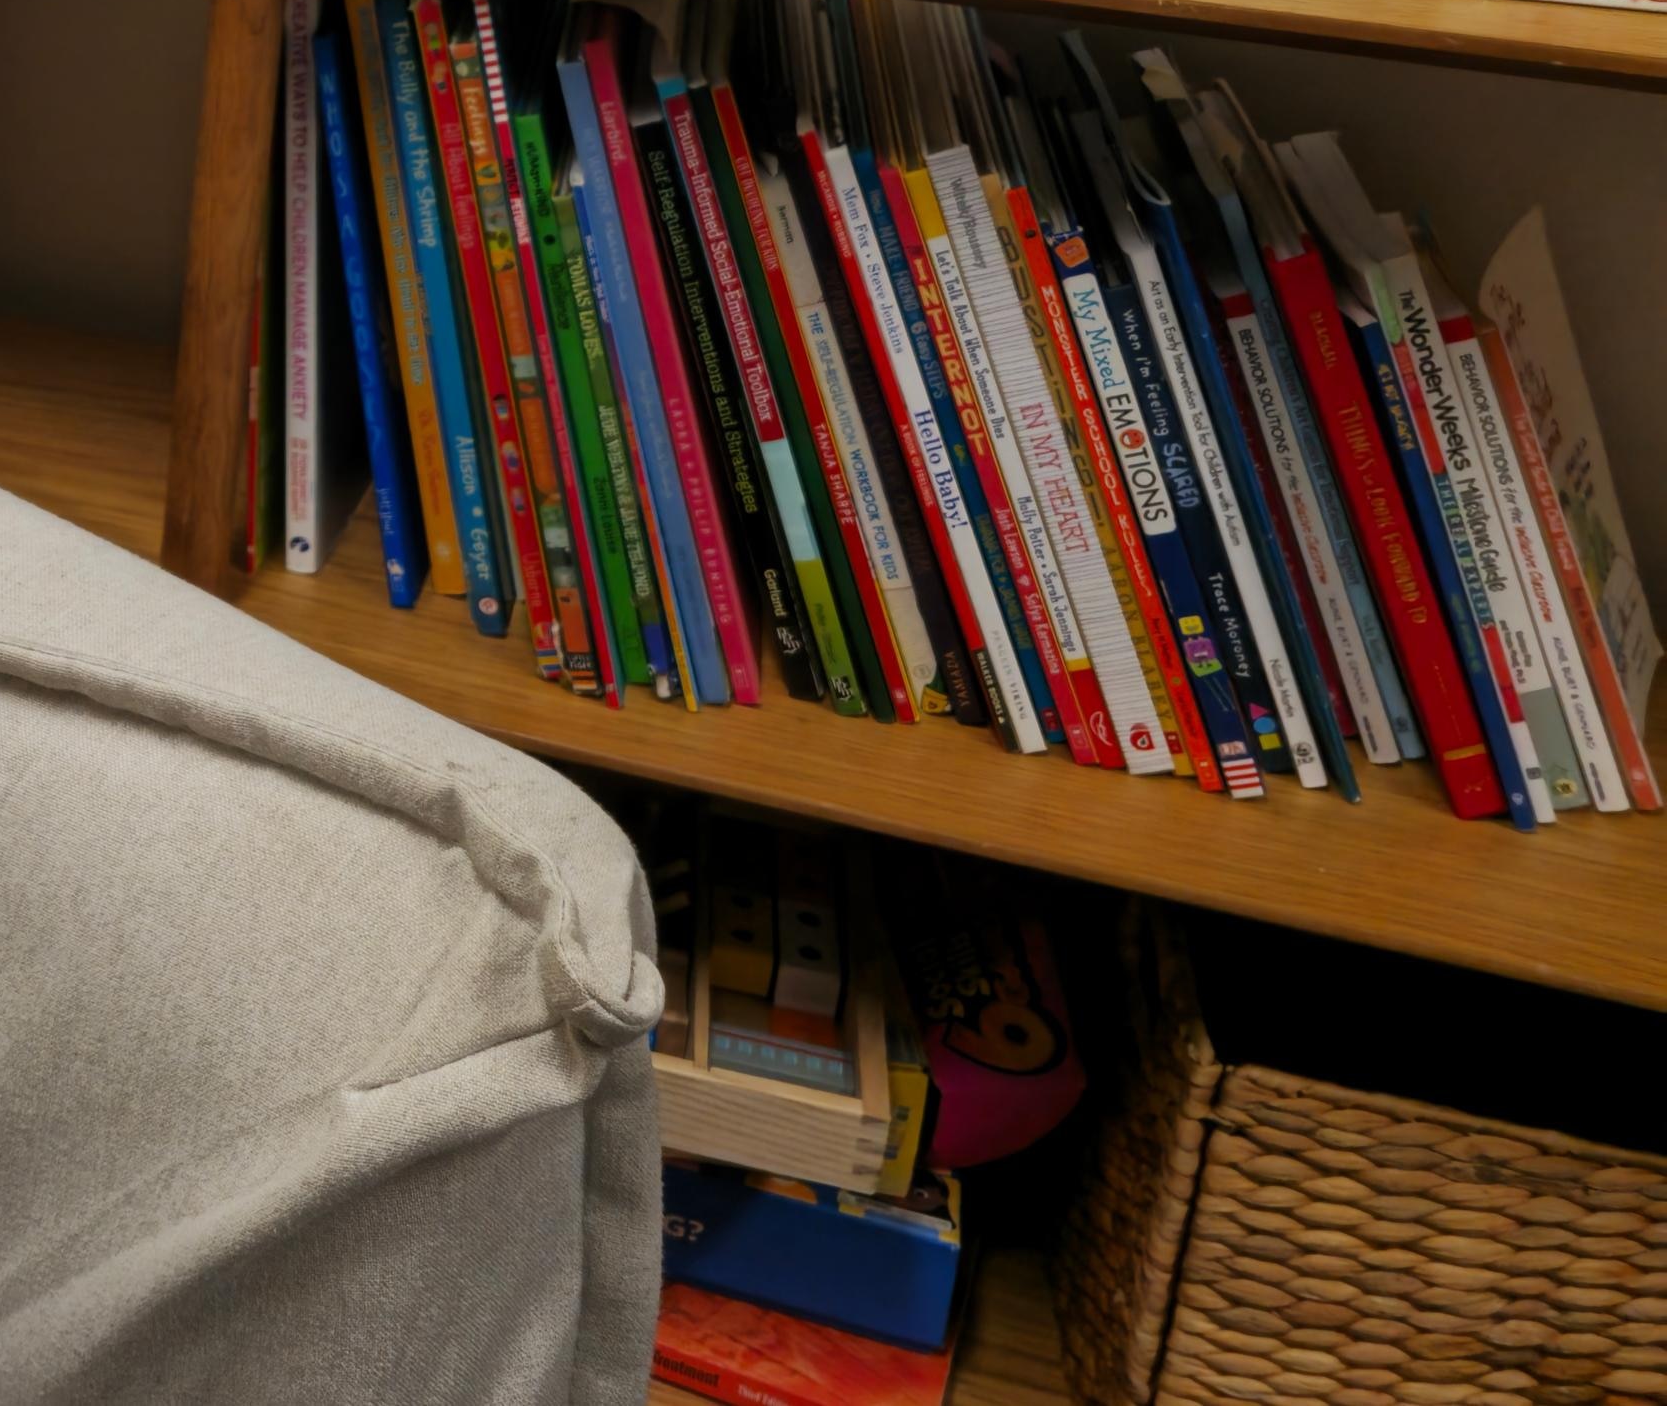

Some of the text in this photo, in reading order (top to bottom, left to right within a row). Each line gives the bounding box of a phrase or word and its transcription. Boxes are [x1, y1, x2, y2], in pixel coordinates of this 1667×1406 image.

[290, 72, 308, 121] WAYS
[459, 84, 496, 157] Feelings
[292, 126, 307, 147] TO
[389, 20, 442, 249] The Bully and the Shrimp
[445, 145, 471, 193] About
[292, 152, 308, 192] HELP
[292, 197, 308, 276] CHILDREN
[451, 192, 482, 250] Feelings
[566, 255, 591, 308] TOMAS
[671, 109, 779, 426] Trauma-Informed Social-Emotional Toolbox
[841, 187, 908, 355] Mem Fox Steve Jenkins
[1397, 288, 1418, 311] The
[291, 280, 307, 351] MANAGE
[643, 148, 761, 515] Self-Regulation Interventions and Strategies
[910, 319, 928, 335] 6
[913, 333, 935, 361] Easy
[934, 248, 1009, 439] Let's Talk About When Someone Dies
[292, 354, 306, 420] ANXIETY
[1401, 307, 1450, 399] Wonder
[1458, 352, 1491, 414] BEHAVIOR
[1071, 285, 1170, 523] My Mixed EMOTIONS
[1117, 307, 1199, 510] When I'm Feeling SCARED
[1147, 278, 1243, 547] Art as an Early Intervention Tool for Children with Autism
[1237, 326, 1301, 491] BEHAVIOR SOLUTIONS for the
[1335, 399, 1377, 471] THINGS
[1429, 395, 1473, 473] Weeks
[806, 311, 899, 581] THE SELF-REGULATION WORKBOOK FOR KIDS
[812, 422, 853, 526] TANJA SHARPE
[900, 430, 934, 507] BOOK OF FEELINGS
[913, 408, 968, 531] Hello Baby!
[1018, 400, 1090, 557] IN MY HEART
[1080, 406, 1124, 507] SCHOOL
[1478, 413, 1514, 486] SOLUTIONS
[454, 432, 495, 581] Allison Geyer
[667, 396, 733, 626] LAURA PHILIP BUNTING
[992, 506, 1013, 529] Josh
[1454, 476, 1495, 549] Milestone
[1500, 485, 1520, 506] for
[1508, 504, 1525, 524] the
[520, 550, 548, 609] Usborne
[999, 526, 1027, 570] Lawson
[1014, 494, 1079, 654] Molly Potter Sarah Jennings
[1102, 544, 1139, 624] AARON
[1436, 478, 1456, 507] THE
[1447, 513, 1471, 554] REAL
[1462, 559, 1495, 629] EXPERTS
[1475, 546, 1511, 594] Guide
[760, 567, 789, 618] Garland
[1021, 591, 1046, 623] Sofya
[1206, 571, 1256, 681] Trace Moroney
[975, 651, 1004, 716] WALKER BOOKS
[1268, 657, 1297, 718] Nicole Martin
